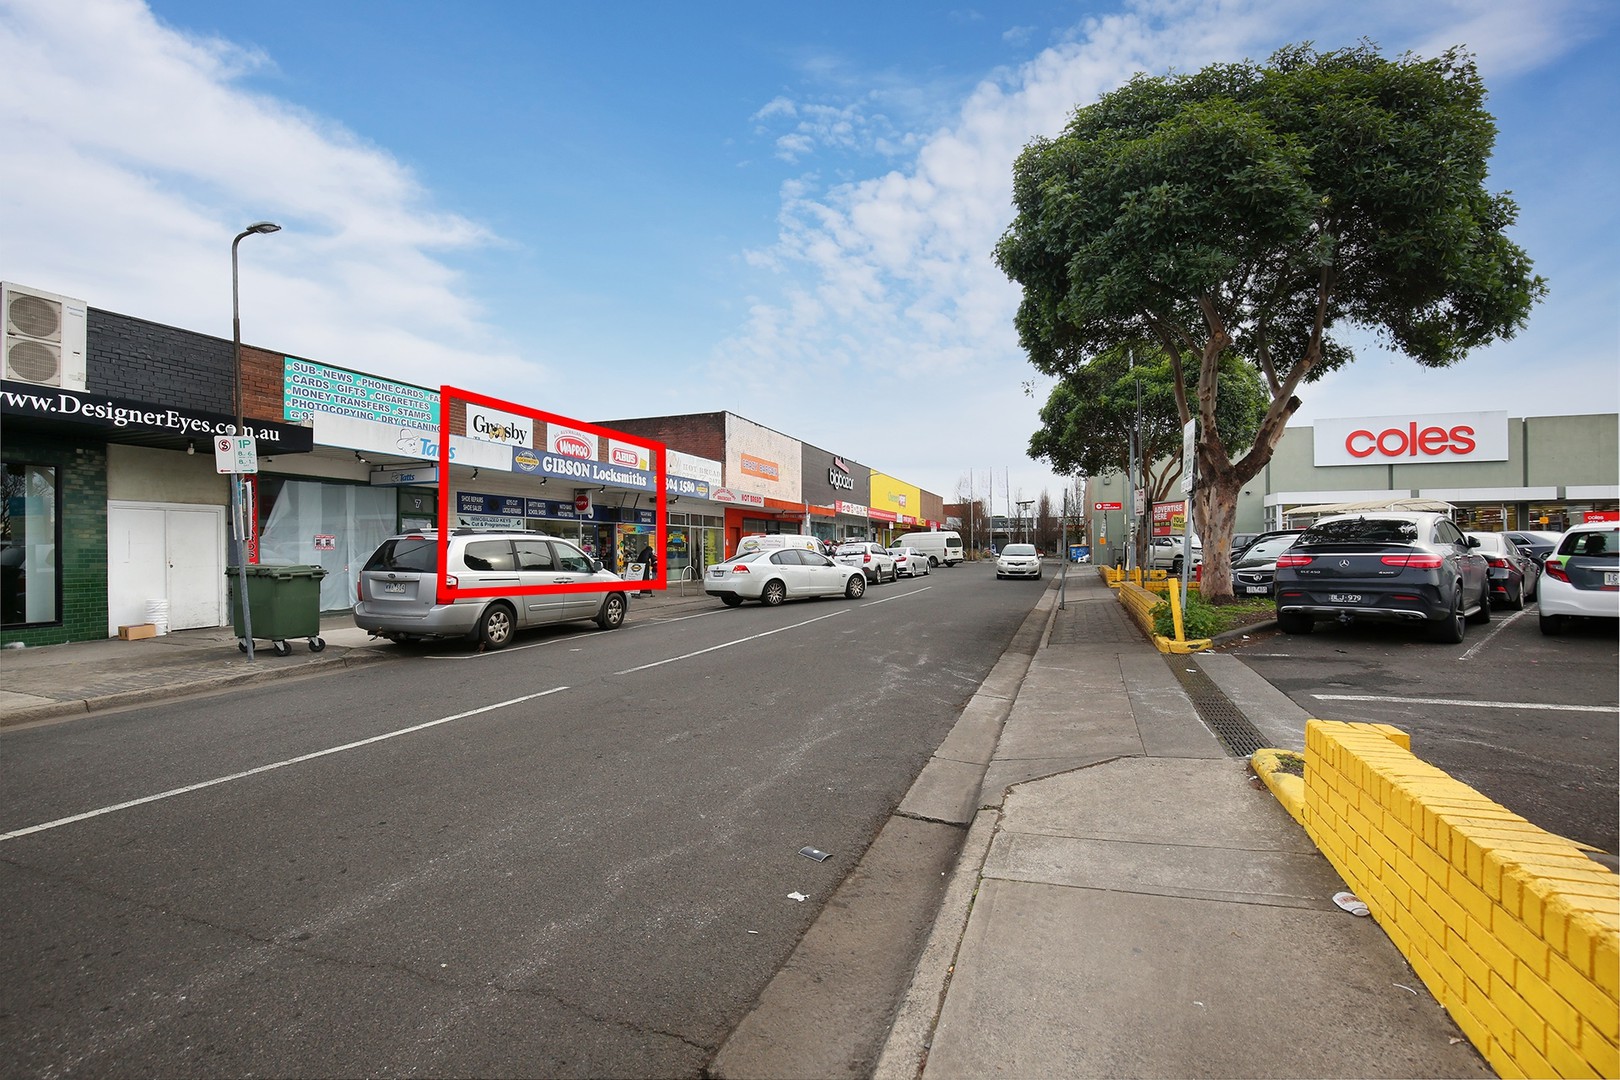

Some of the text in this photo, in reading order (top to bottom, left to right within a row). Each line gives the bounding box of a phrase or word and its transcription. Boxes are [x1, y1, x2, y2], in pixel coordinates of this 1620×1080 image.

[293, 362, 353, 383] SUB NEWS
[292, 374, 430, 410] CARDS GIFTS CIGARETTES
[362, 378, 440, 402] PHONE CARDS FA
[291, 398, 374, 420] PHOTOCOPYING
[381, 415, 399, 425] DRY
[292, 386, 431, 421] MONEY TRANSFERS STAMPS
[0, 391, 280, 441] ww.DesignerEyes.com.au
[473, 415, 527, 445] Grsby
[1345, 421, 1476, 458] coles
[238, 439, 251, 449] 1P
[421, 438, 457, 459] Tas
[560, 440, 588, 458] WAPROO
[615, 452, 636, 464] ABUS
[400, 473, 415, 481] Tatts
[542, 456, 647, 487] GIBSON Locksmiths
[679, 480, 695, 493] 1580
[415, 499, 421, 509] 7
[1154, 504, 1183, 513] ADVERTISE
